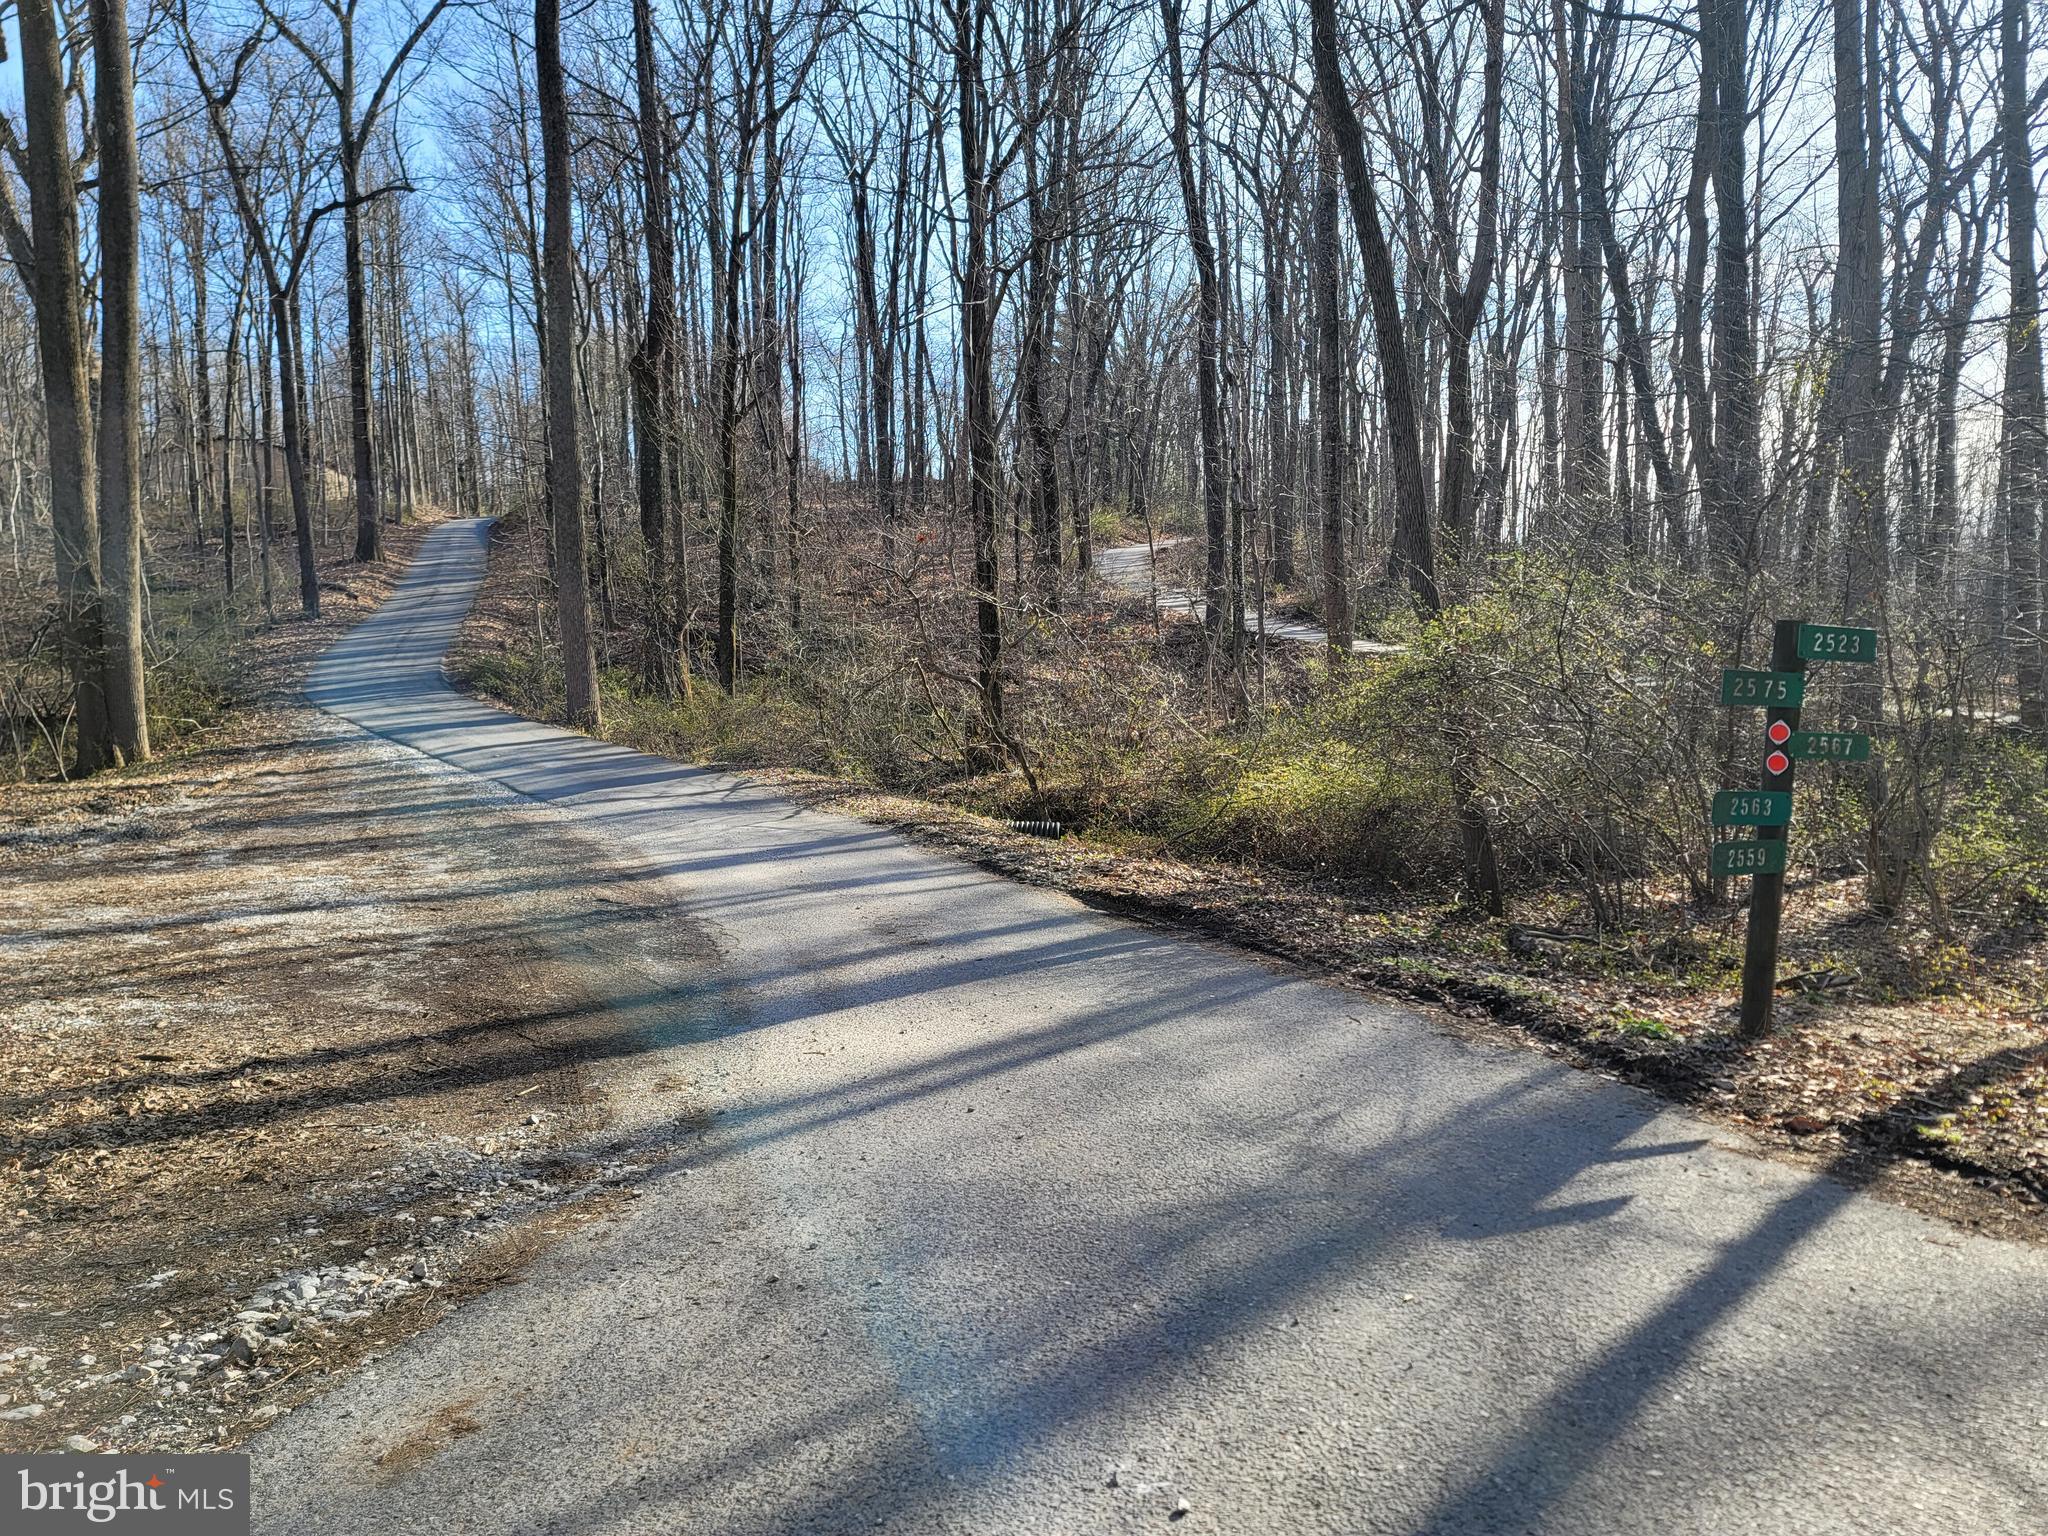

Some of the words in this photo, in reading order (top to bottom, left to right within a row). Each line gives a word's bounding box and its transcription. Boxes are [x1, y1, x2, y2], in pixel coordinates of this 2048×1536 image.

[1813, 632, 1860, 654] 2523
[1733, 678, 1787, 700] 2575
[1807, 736, 1853, 756] 2567
[1730, 798, 1772, 817] 2563
[1727, 848, 1766, 868] 2559
